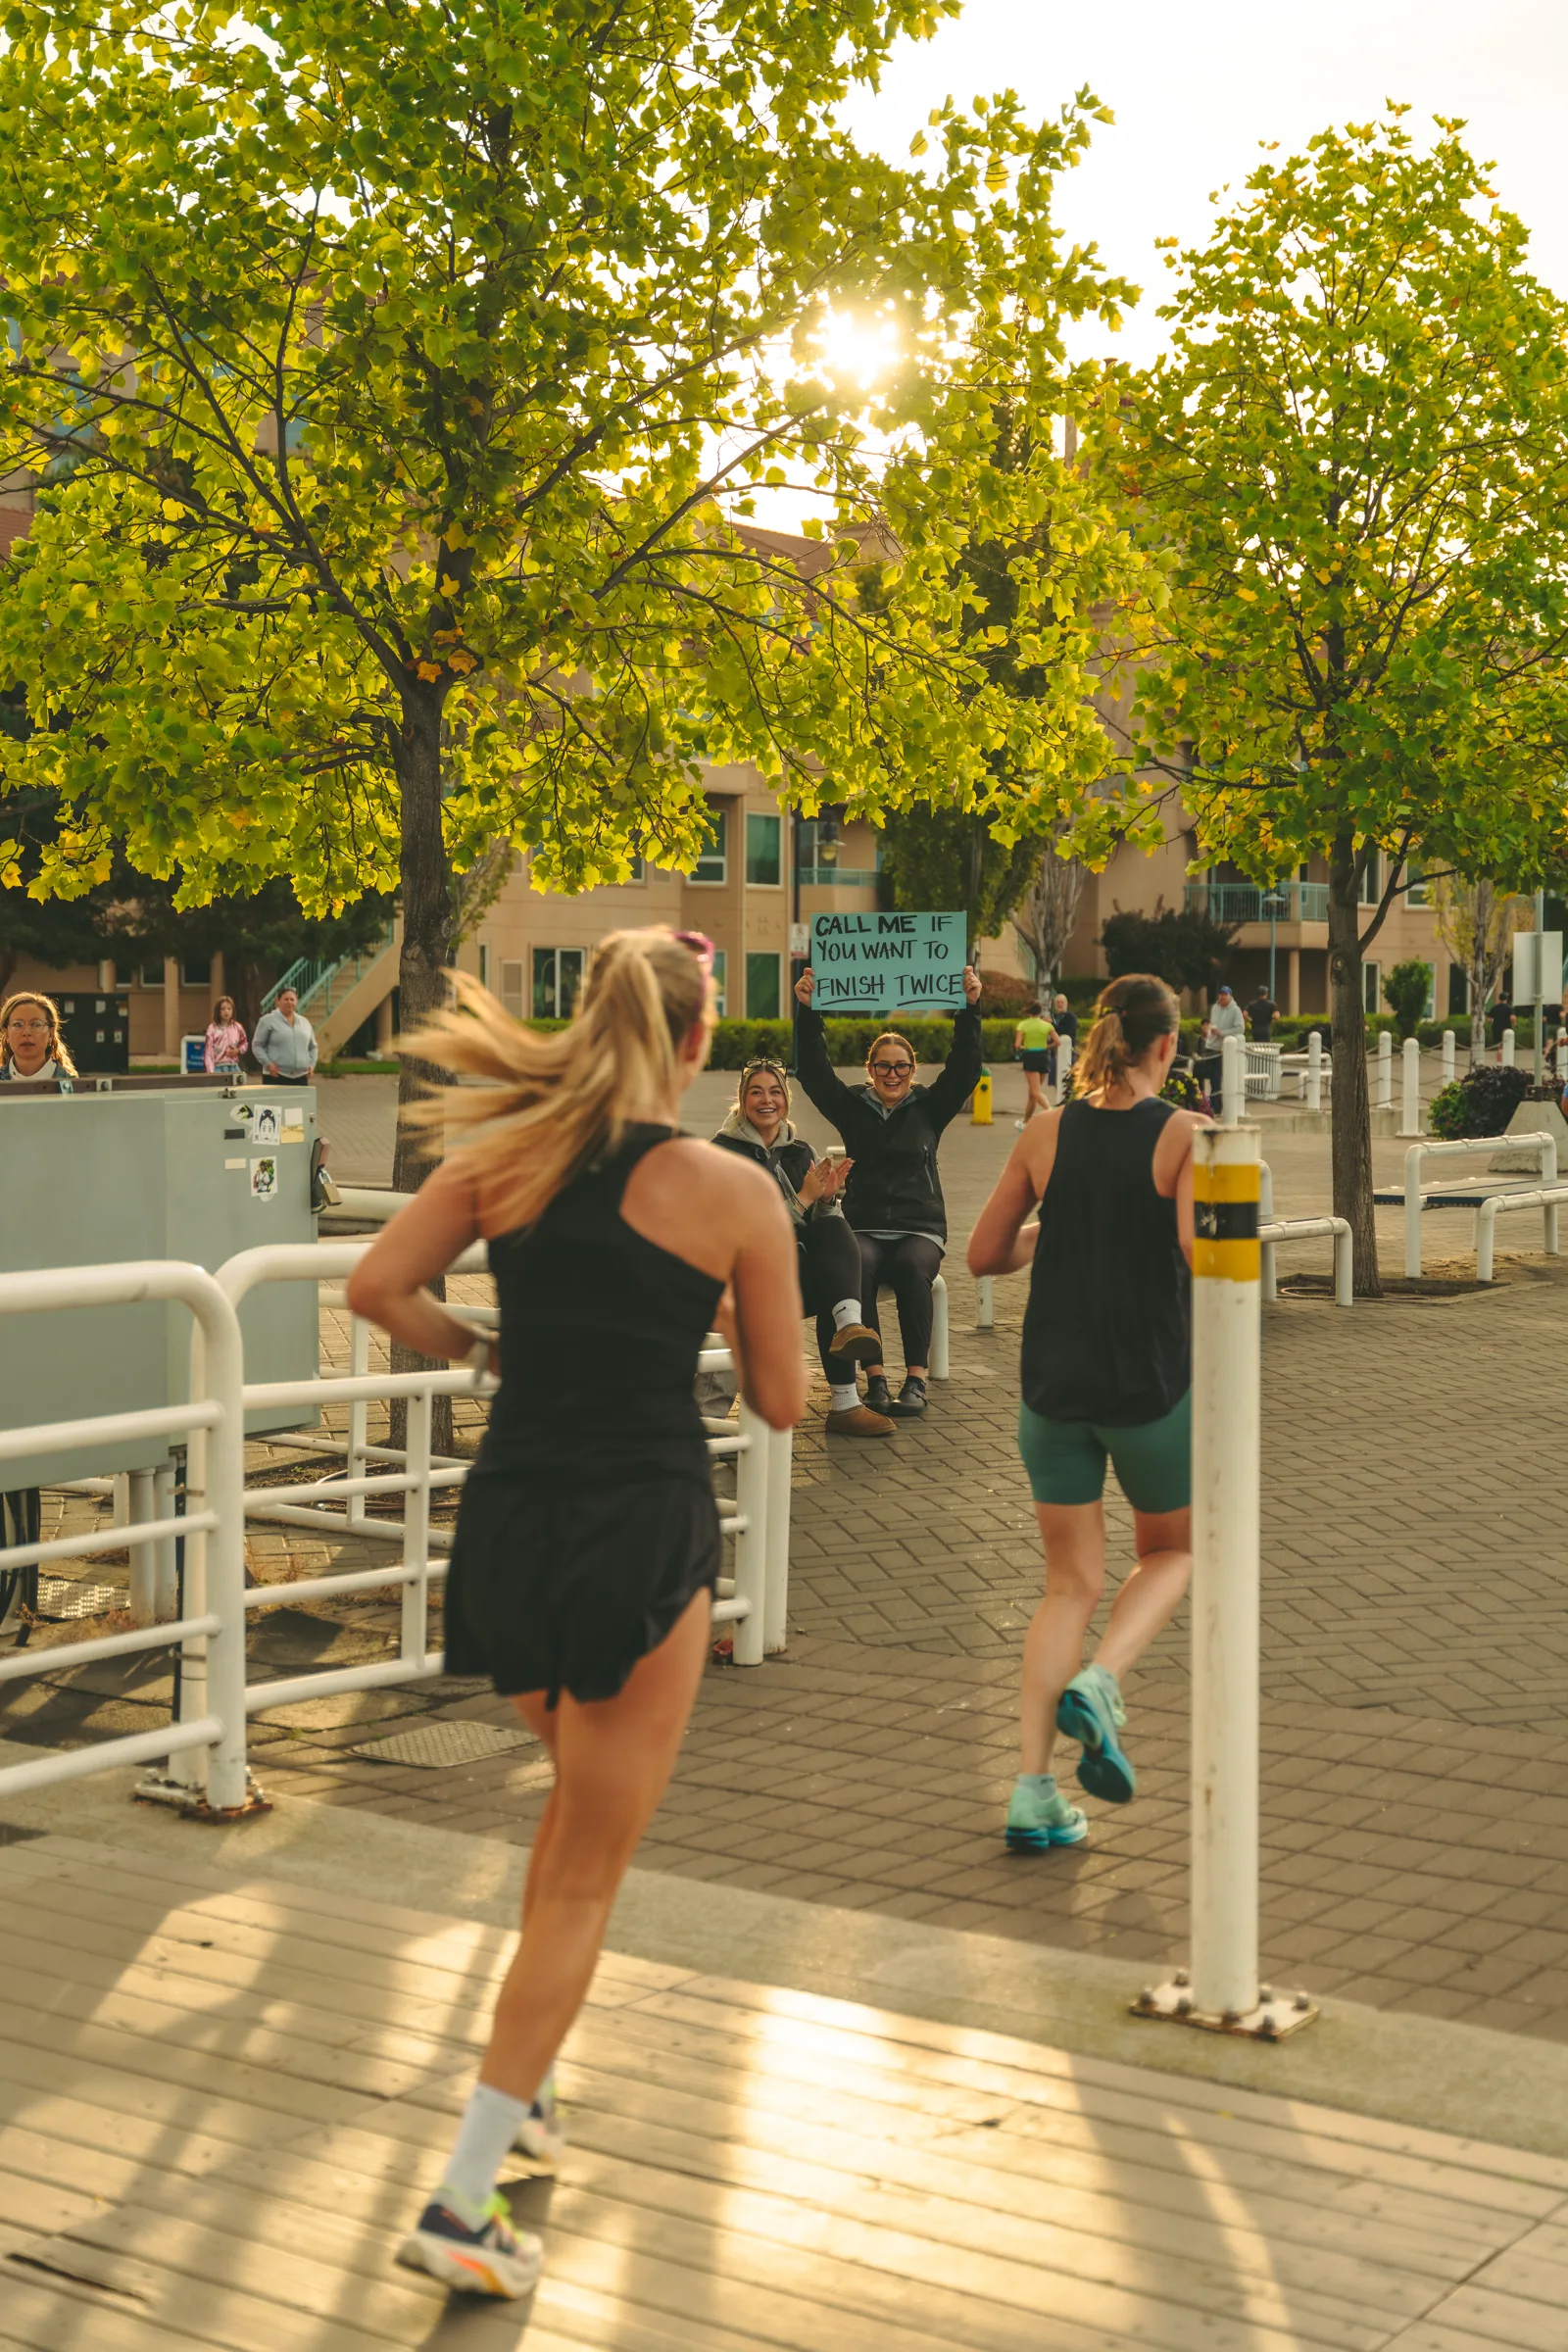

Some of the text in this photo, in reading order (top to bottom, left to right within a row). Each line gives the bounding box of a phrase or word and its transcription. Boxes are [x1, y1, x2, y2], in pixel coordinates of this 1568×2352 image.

[815, 914, 953, 937] CALL ME IF
[816, 939, 949, 962] YOU WANT TO
[815, 973, 963, 998] FINISH TWICE
